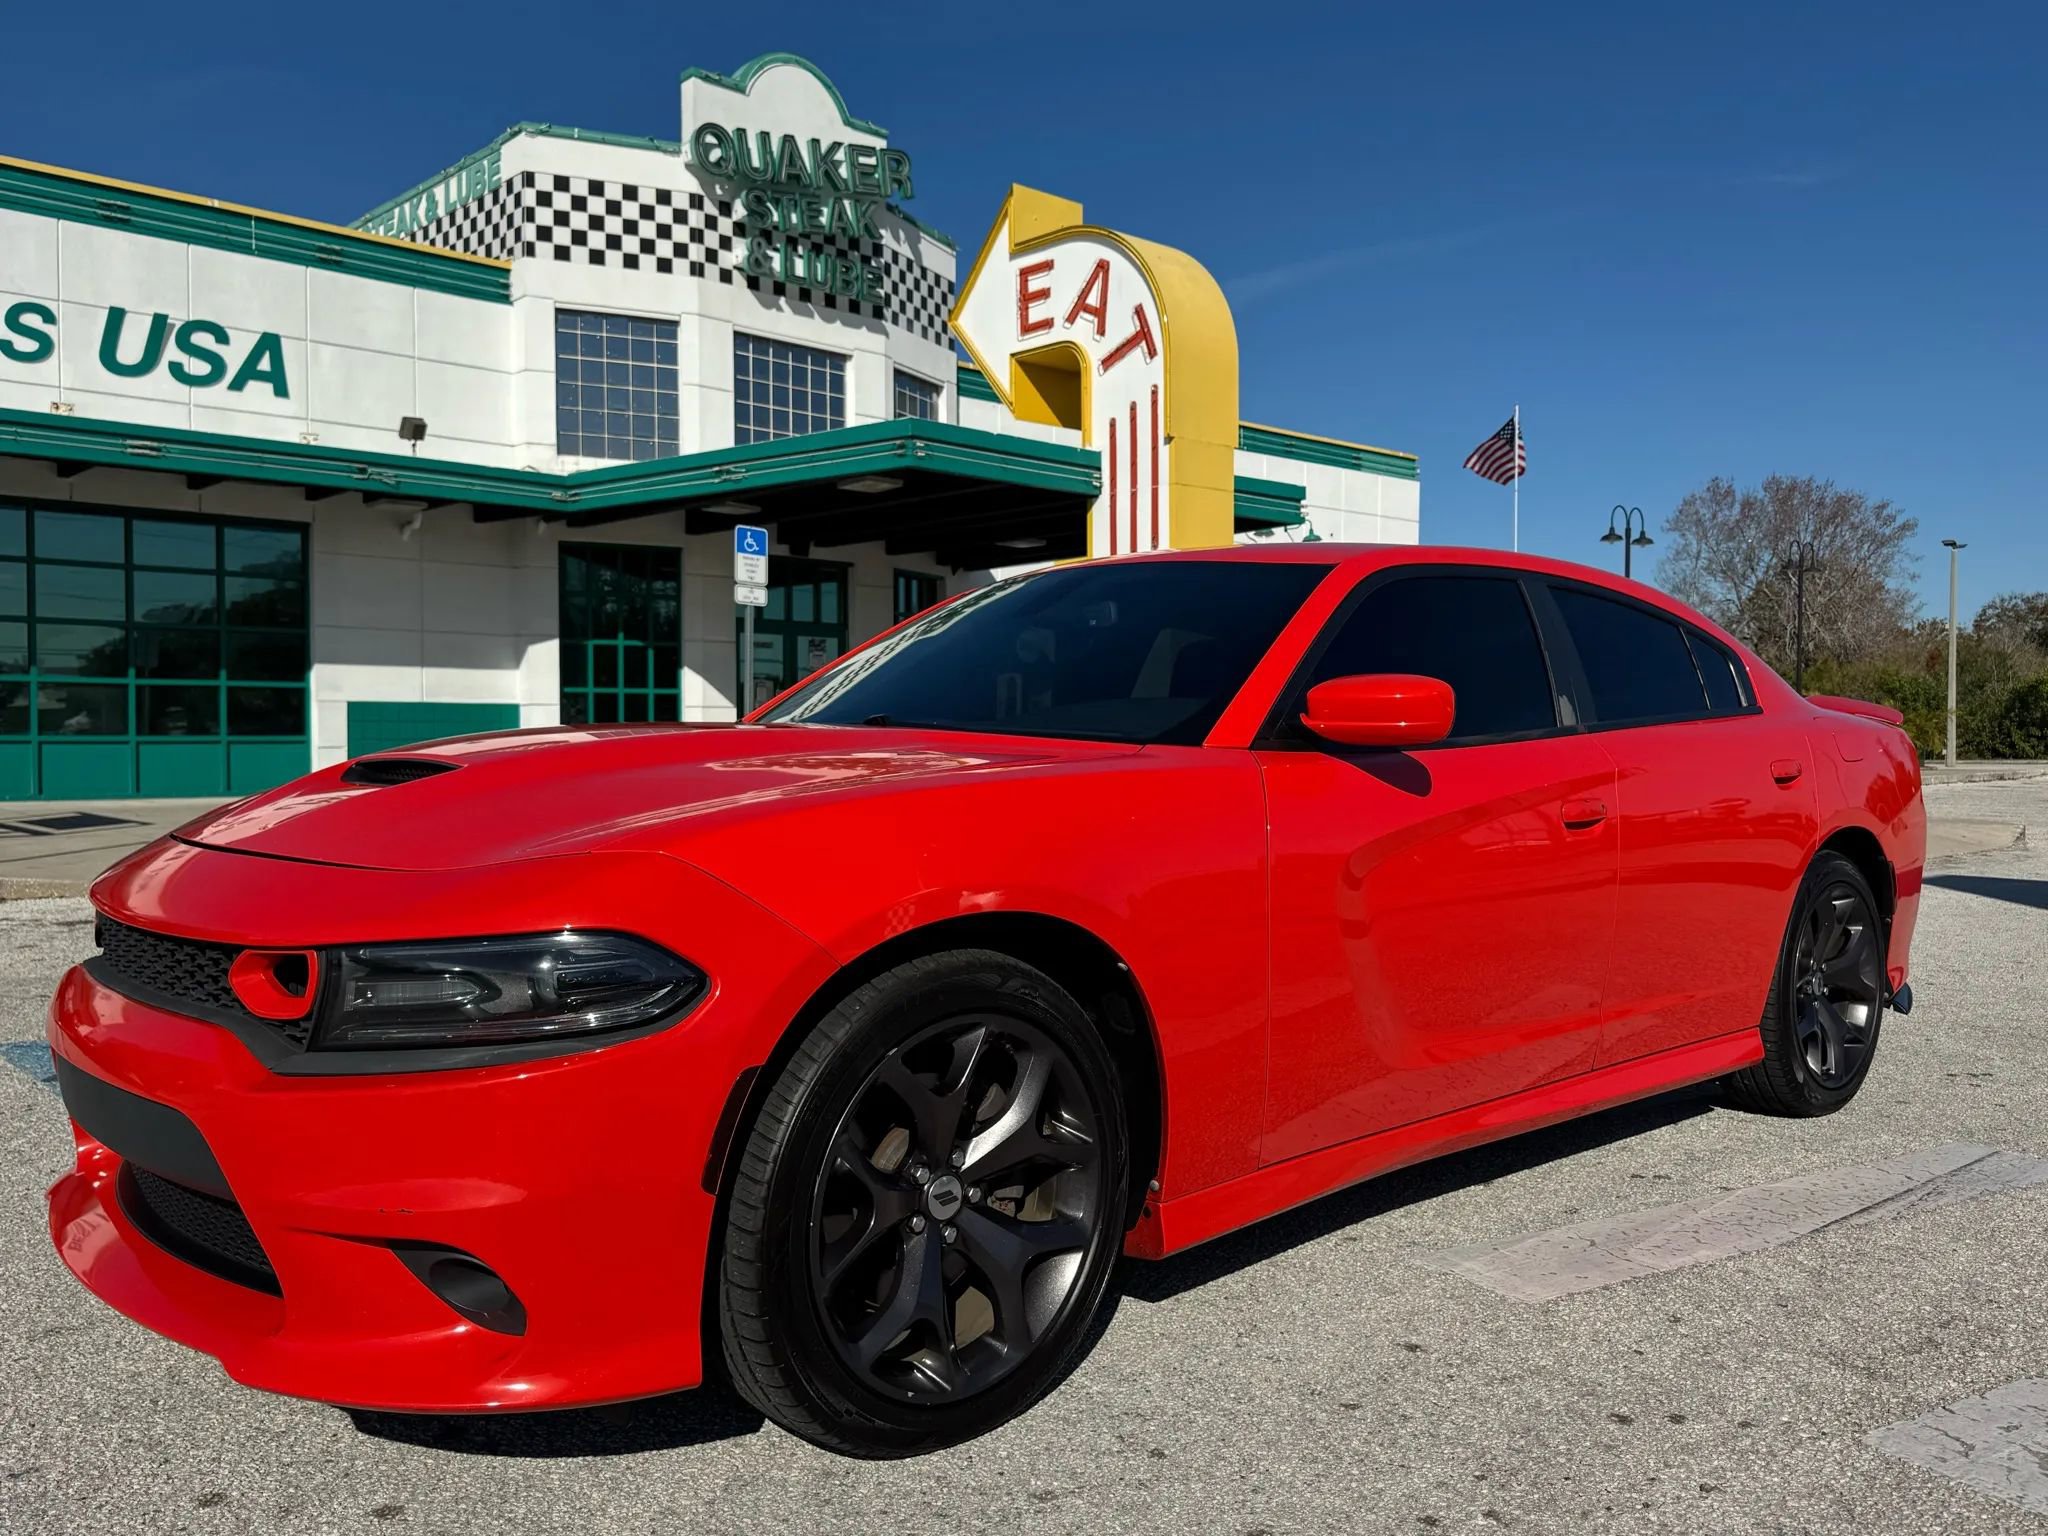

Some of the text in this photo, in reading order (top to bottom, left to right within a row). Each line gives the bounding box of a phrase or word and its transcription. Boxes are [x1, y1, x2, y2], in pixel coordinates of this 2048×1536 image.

[444, 150, 503, 216] LUBE
[690, 122, 912, 198] QUAKER
[742, 187, 881, 239] STEAK
[743, 235, 886, 304] & LUBE
[98, 305, 290, 399] USA
[1018, 257, 1159, 375] EAT
